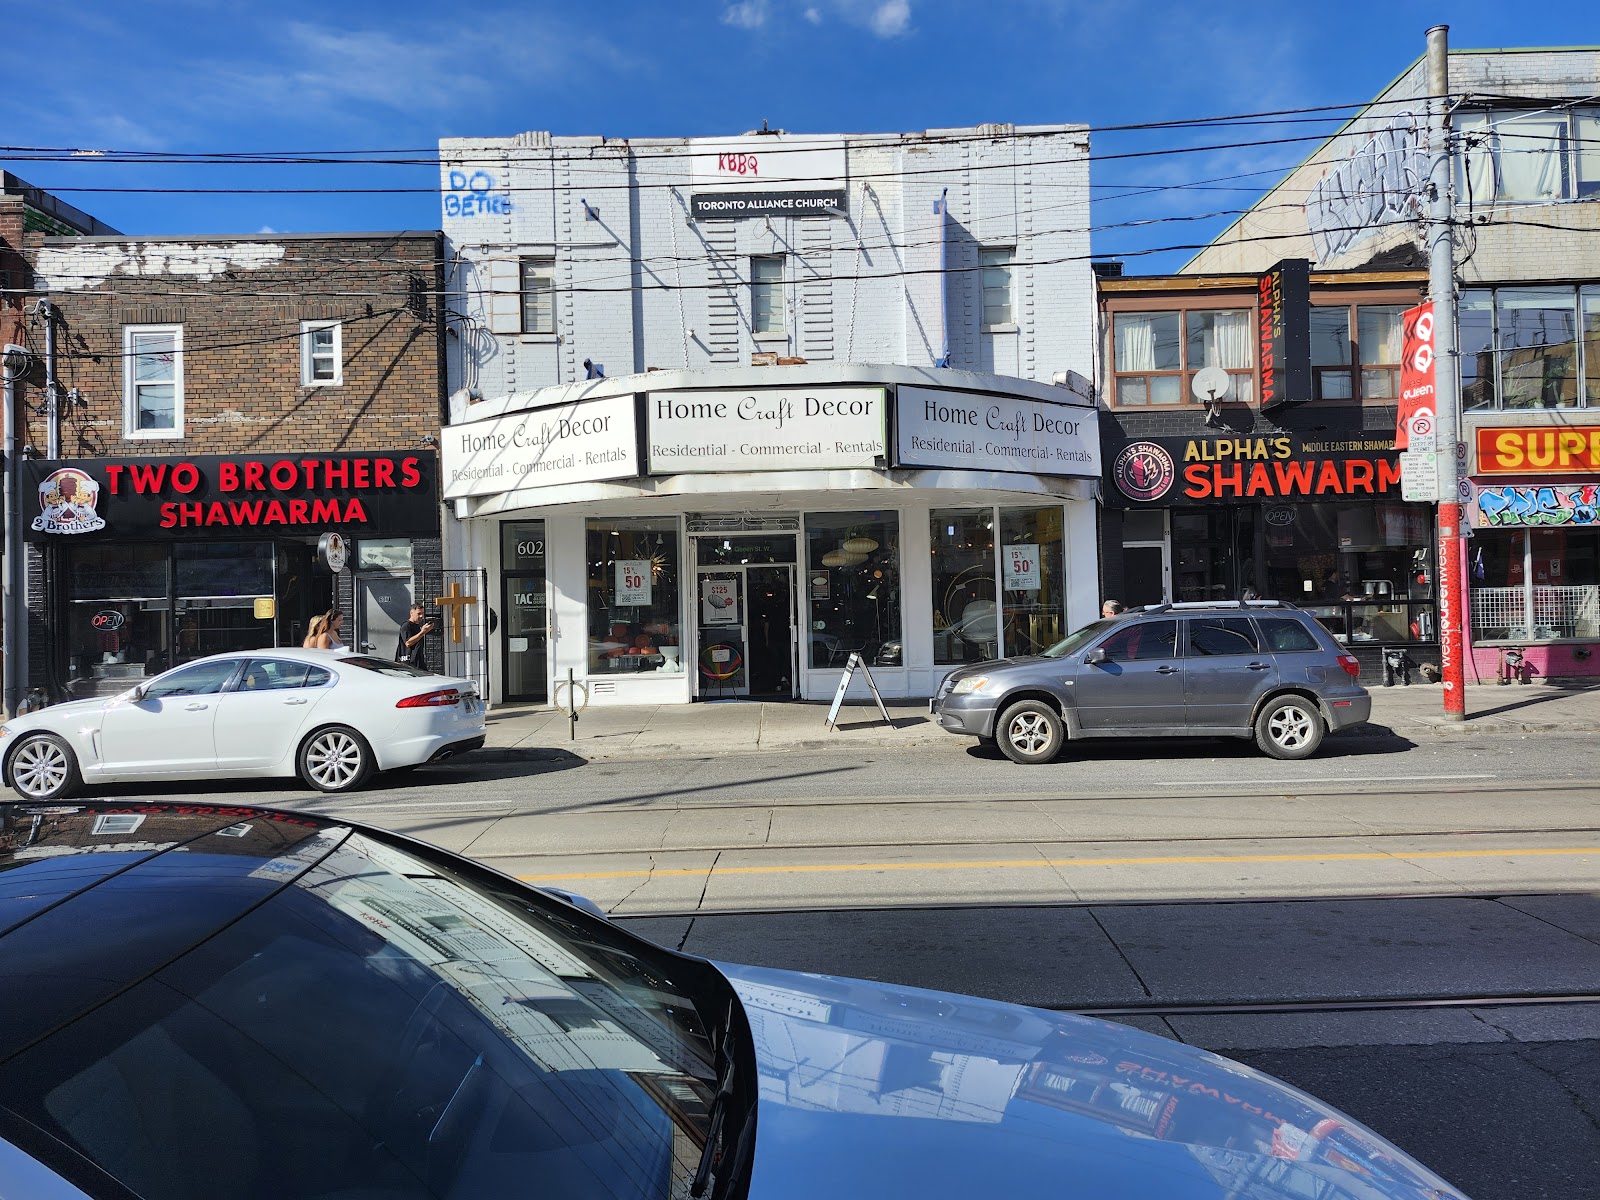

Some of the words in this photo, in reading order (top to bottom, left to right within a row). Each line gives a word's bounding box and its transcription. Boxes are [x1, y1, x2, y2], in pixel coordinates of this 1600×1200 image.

[718, 152, 758, 175] KBBQ
[450, 171, 495, 195] DO
[697, 200, 745, 211] TORONTO
[747, 199, 794, 210] ALLIANCE
[795, 198, 838, 209] CHURCH
[1272, 271, 1281, 339] ALPHA'S
[1259, 275, 1274, 404] SHAWARMA
[657, 400, 727, 420] Home
[737, 397, 794, 429] Craft
[805, 397, 874, 417] Decor
[924, 400, 978, 426] Home
[986, 405, 1028, 442] Craft
[1033, 412, 1080, 436] Decor
[461, 432, 506, 454] Home
[512, 422, 551, 455] Craft
[559, 414, 612, 440] Decor
[1302, 442, 1330, 453] MIDDLE
[1330, 441, 1363, 452] EASTERN
[1364, 440, 1396, 451] SHAWAR
[652, 444, 727, 458] Residential
[740, 443, 822, 457] Commercial
[835, 439, 883, 454] Rentals
[911, 435, 975, 454] Residential
[985, 442, 1049, 460] Commercial
[1056, 448, 1092, 463] Rentals
[1117, 447, 1137, 474] ALPHA'S
[1183, 437, 1292, 462] ALPHA'S
[105, 462, 200, 494] TWO
[219, 457, 421, 492] BROTHERS
[451, 463, 504, 483] Residential
[512, 457, 575, 476] Commercial
[585, 447, 627, 466] Rentals
[1183, 459, 1402, 499] SHAWARM
[35, 519, 43, 528] 2
[47, 519, 103, 531] Brothers
[159, 498, 367, 528] SHAWARMA
[1267, 511, 1293, 521] OPEN
[517, 541, 544, 555] 602
[514, 593, 533, 605] TAC
[92, 615, 122, 626] OPEN
